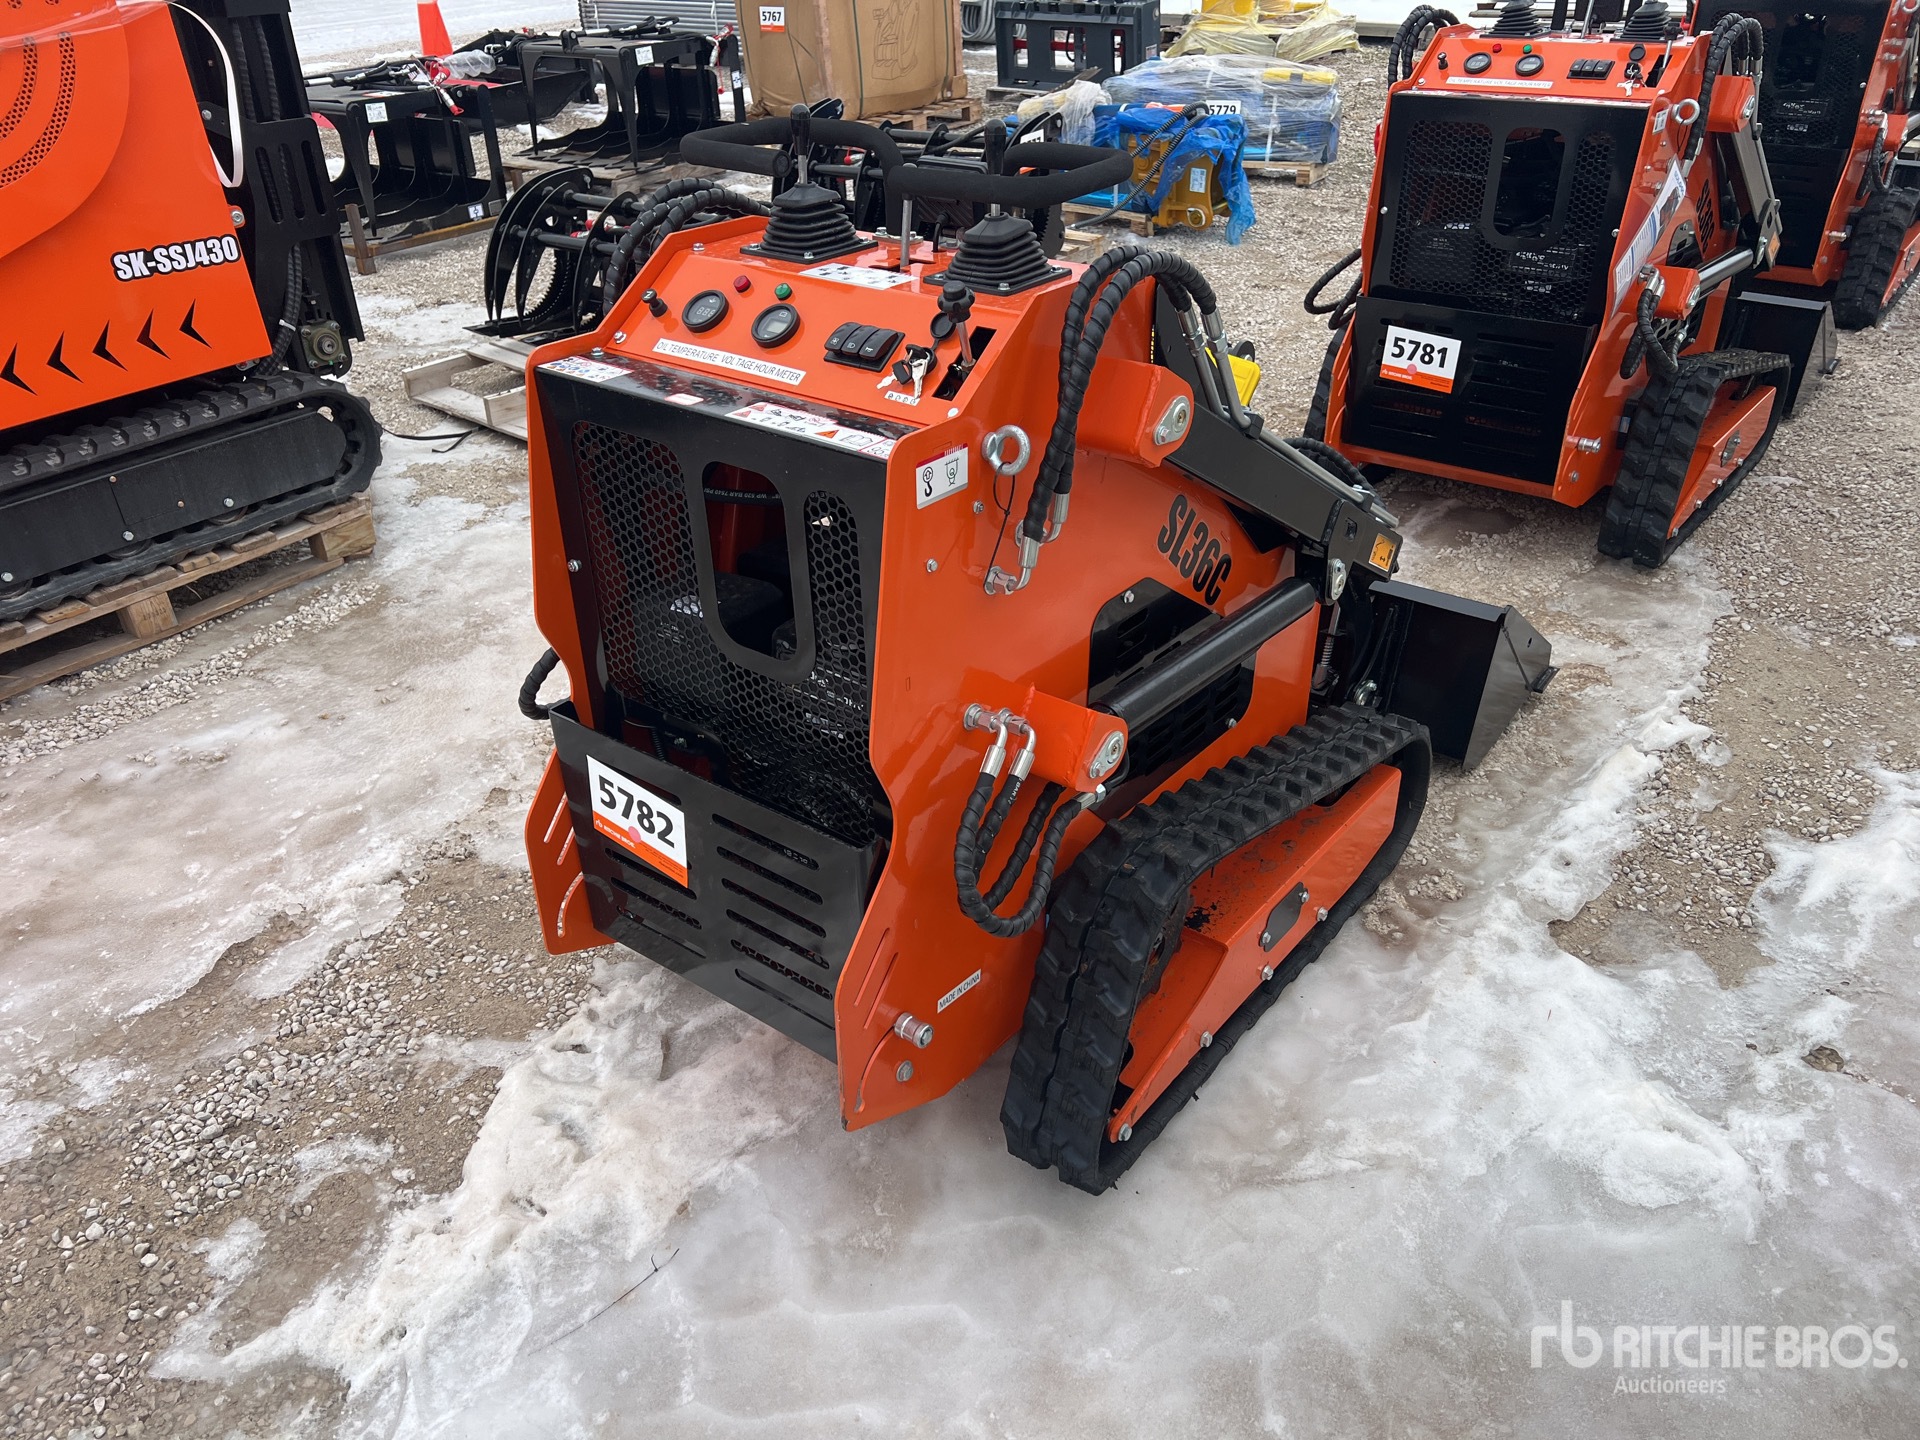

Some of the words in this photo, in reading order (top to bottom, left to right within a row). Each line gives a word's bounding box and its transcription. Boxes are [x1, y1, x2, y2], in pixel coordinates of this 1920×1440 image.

[762, 11, 782, 22] 5767
[1209, 104, 1237, 115] 5779
[112, 236, 239, 280] SK-SSJ430
[656, 341, 667, 351] OIL
[667, 344, 719, 362] TEMPERATURE
[721, 356, 756, 371] VOLTAGE
[773, 368, 801, 382] METER
[1391, 336, 1448, 368] 5781
[1157, 494, 1232, 605] SL36C
[599, 774, 675, 848] 5782
[939, 990, 956, 1010] MADE
[956, 985, 963, 996] IN
[963, 973, 980, 991] CHINA
